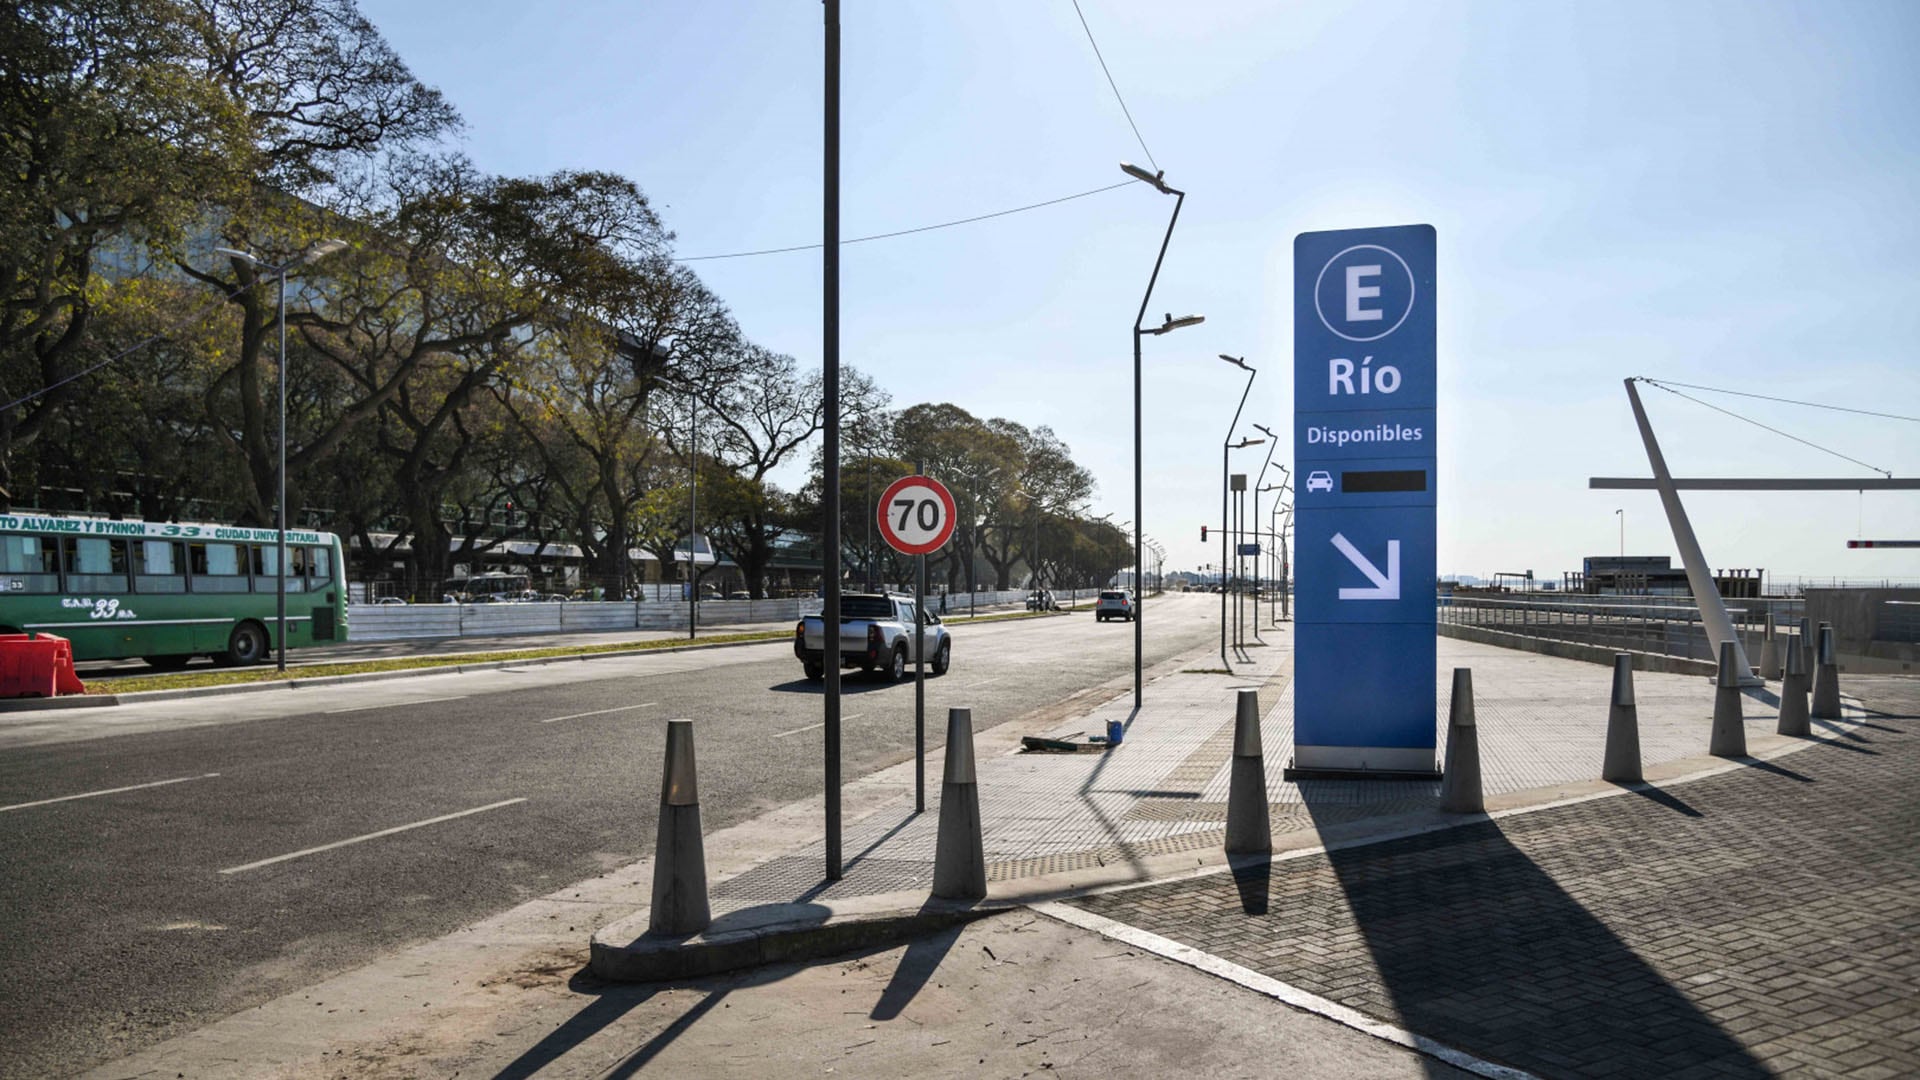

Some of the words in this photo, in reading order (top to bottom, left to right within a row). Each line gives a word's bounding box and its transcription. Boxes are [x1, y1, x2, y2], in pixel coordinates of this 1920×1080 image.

[1345, 264, 1383, 322] E
[1328, 356, 1402, 396] Río
[1307, 424, 1424, 447] Disponibles
[21, 518, 80, 532] ALVAREZ
[84, 521, 93, 533] Y
[96, 523, 146, 535] BYNNON
[160, 525, 201, 537] 33
[215, 528, 250, 540] CIUDAD
[894, 499, 940, 532] 70
[90, 599, 119, 618] 33
